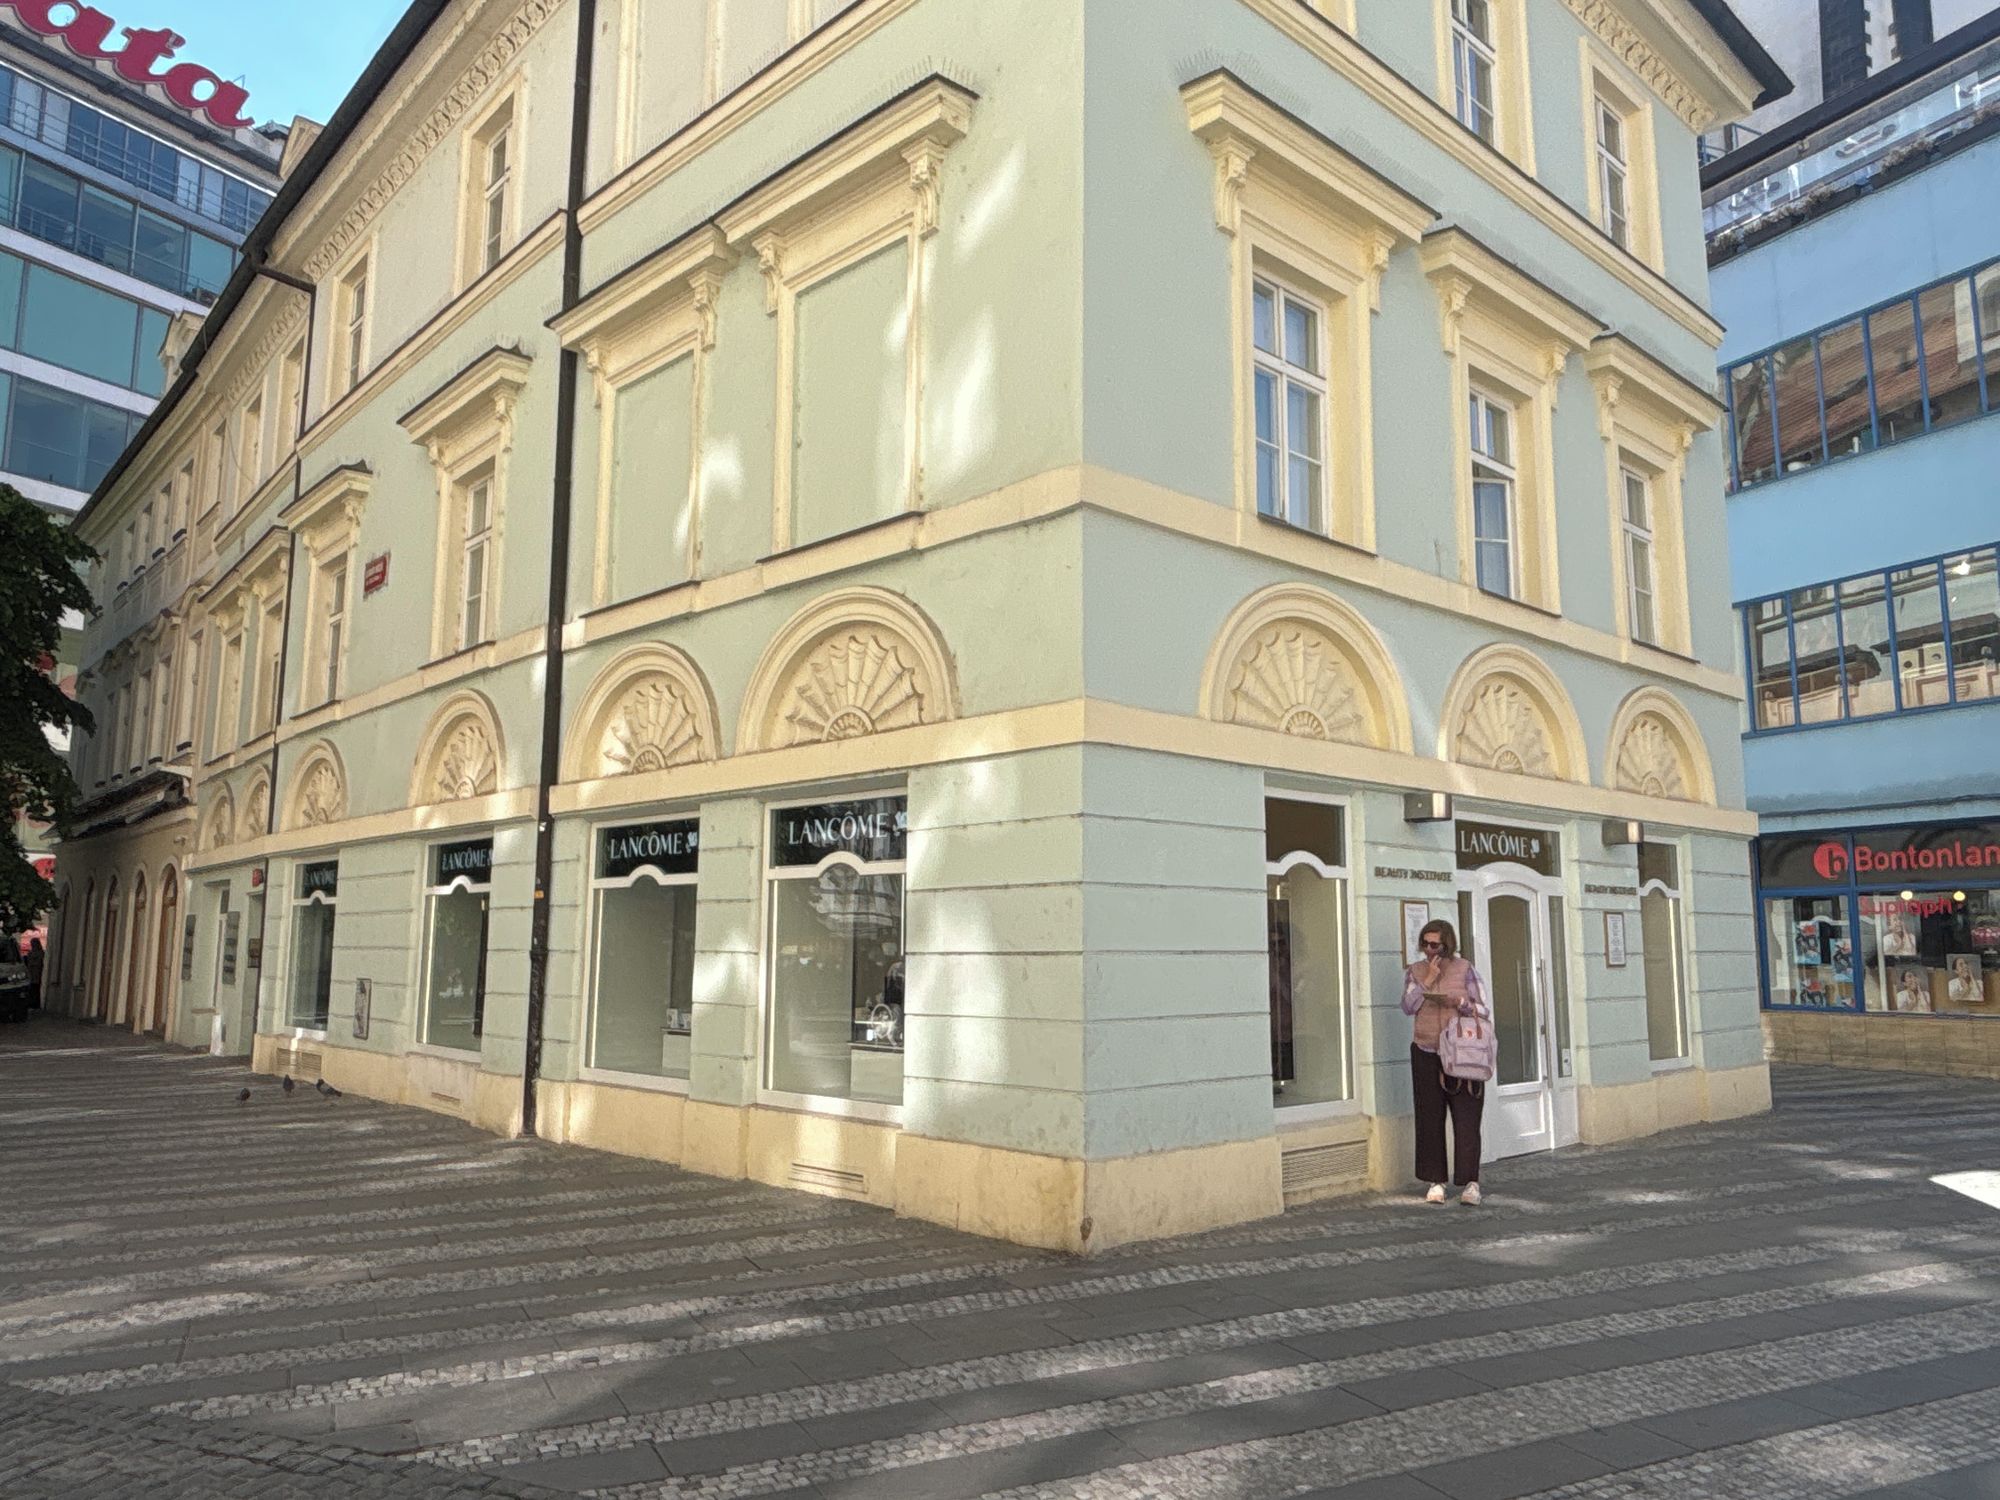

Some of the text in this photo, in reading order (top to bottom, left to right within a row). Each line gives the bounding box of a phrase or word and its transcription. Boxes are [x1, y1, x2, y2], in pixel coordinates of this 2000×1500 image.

[0, 0, 255, 129] ata
[789, 811, 888, 846] LANCÔME
[442, 847, 487, 870] LANCÔME
[609, 831, 683, 859] LANCÔME
[1461, 830, 1529, 859] LANCÔME
